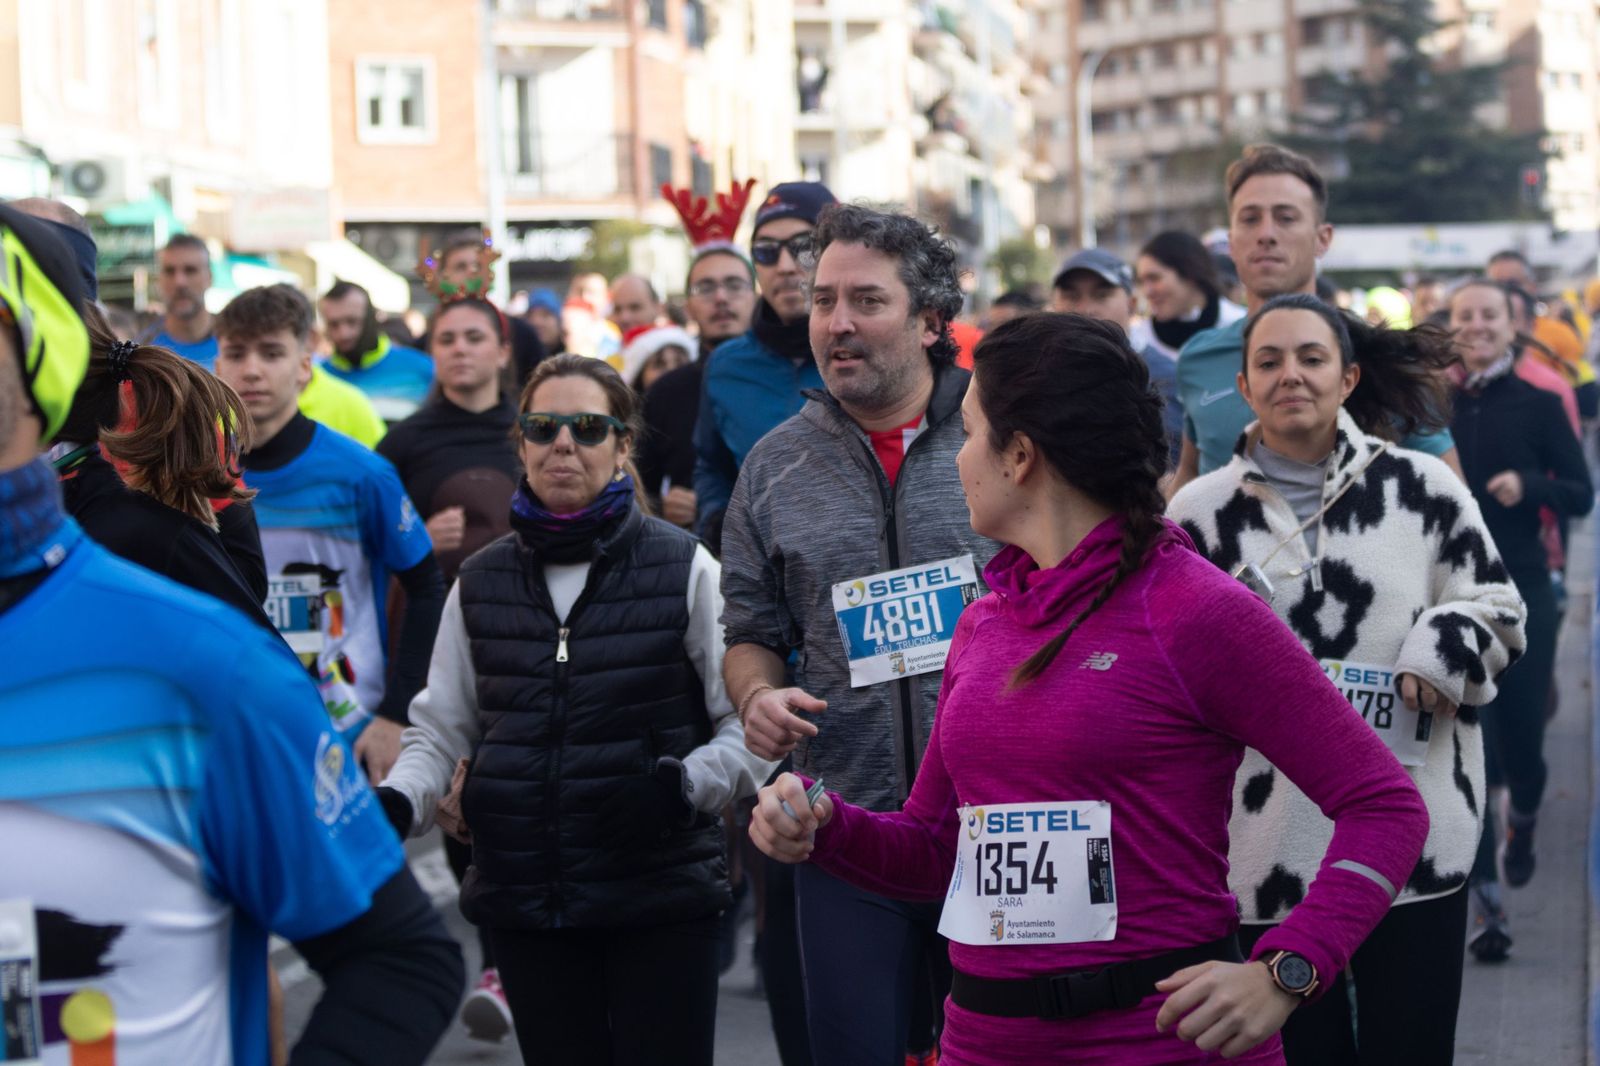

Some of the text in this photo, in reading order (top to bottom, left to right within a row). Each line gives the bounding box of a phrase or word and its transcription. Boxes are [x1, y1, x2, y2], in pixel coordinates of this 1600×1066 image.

[268, 582, 309, 593] TEL
[869, 566, 961, 598] SETEL
[863, 592, 944, 645] 4891
[874, 634, 937, 656] EDU TRUCHAS
[907, 651, 945, 664] Ayuntamiento
[1343, 668, 1393, 687] SET
[1338, 688, 1394, 729] 78
[987, 810, 1091, 834] SETEL
[975, 841, 1058, 897] 1354
[997, 896, 1023, 908] SARA
[1007, 920, 1055, 929] Ayuntamiento
[1007, 930, 1056, 939] de Salamanca
